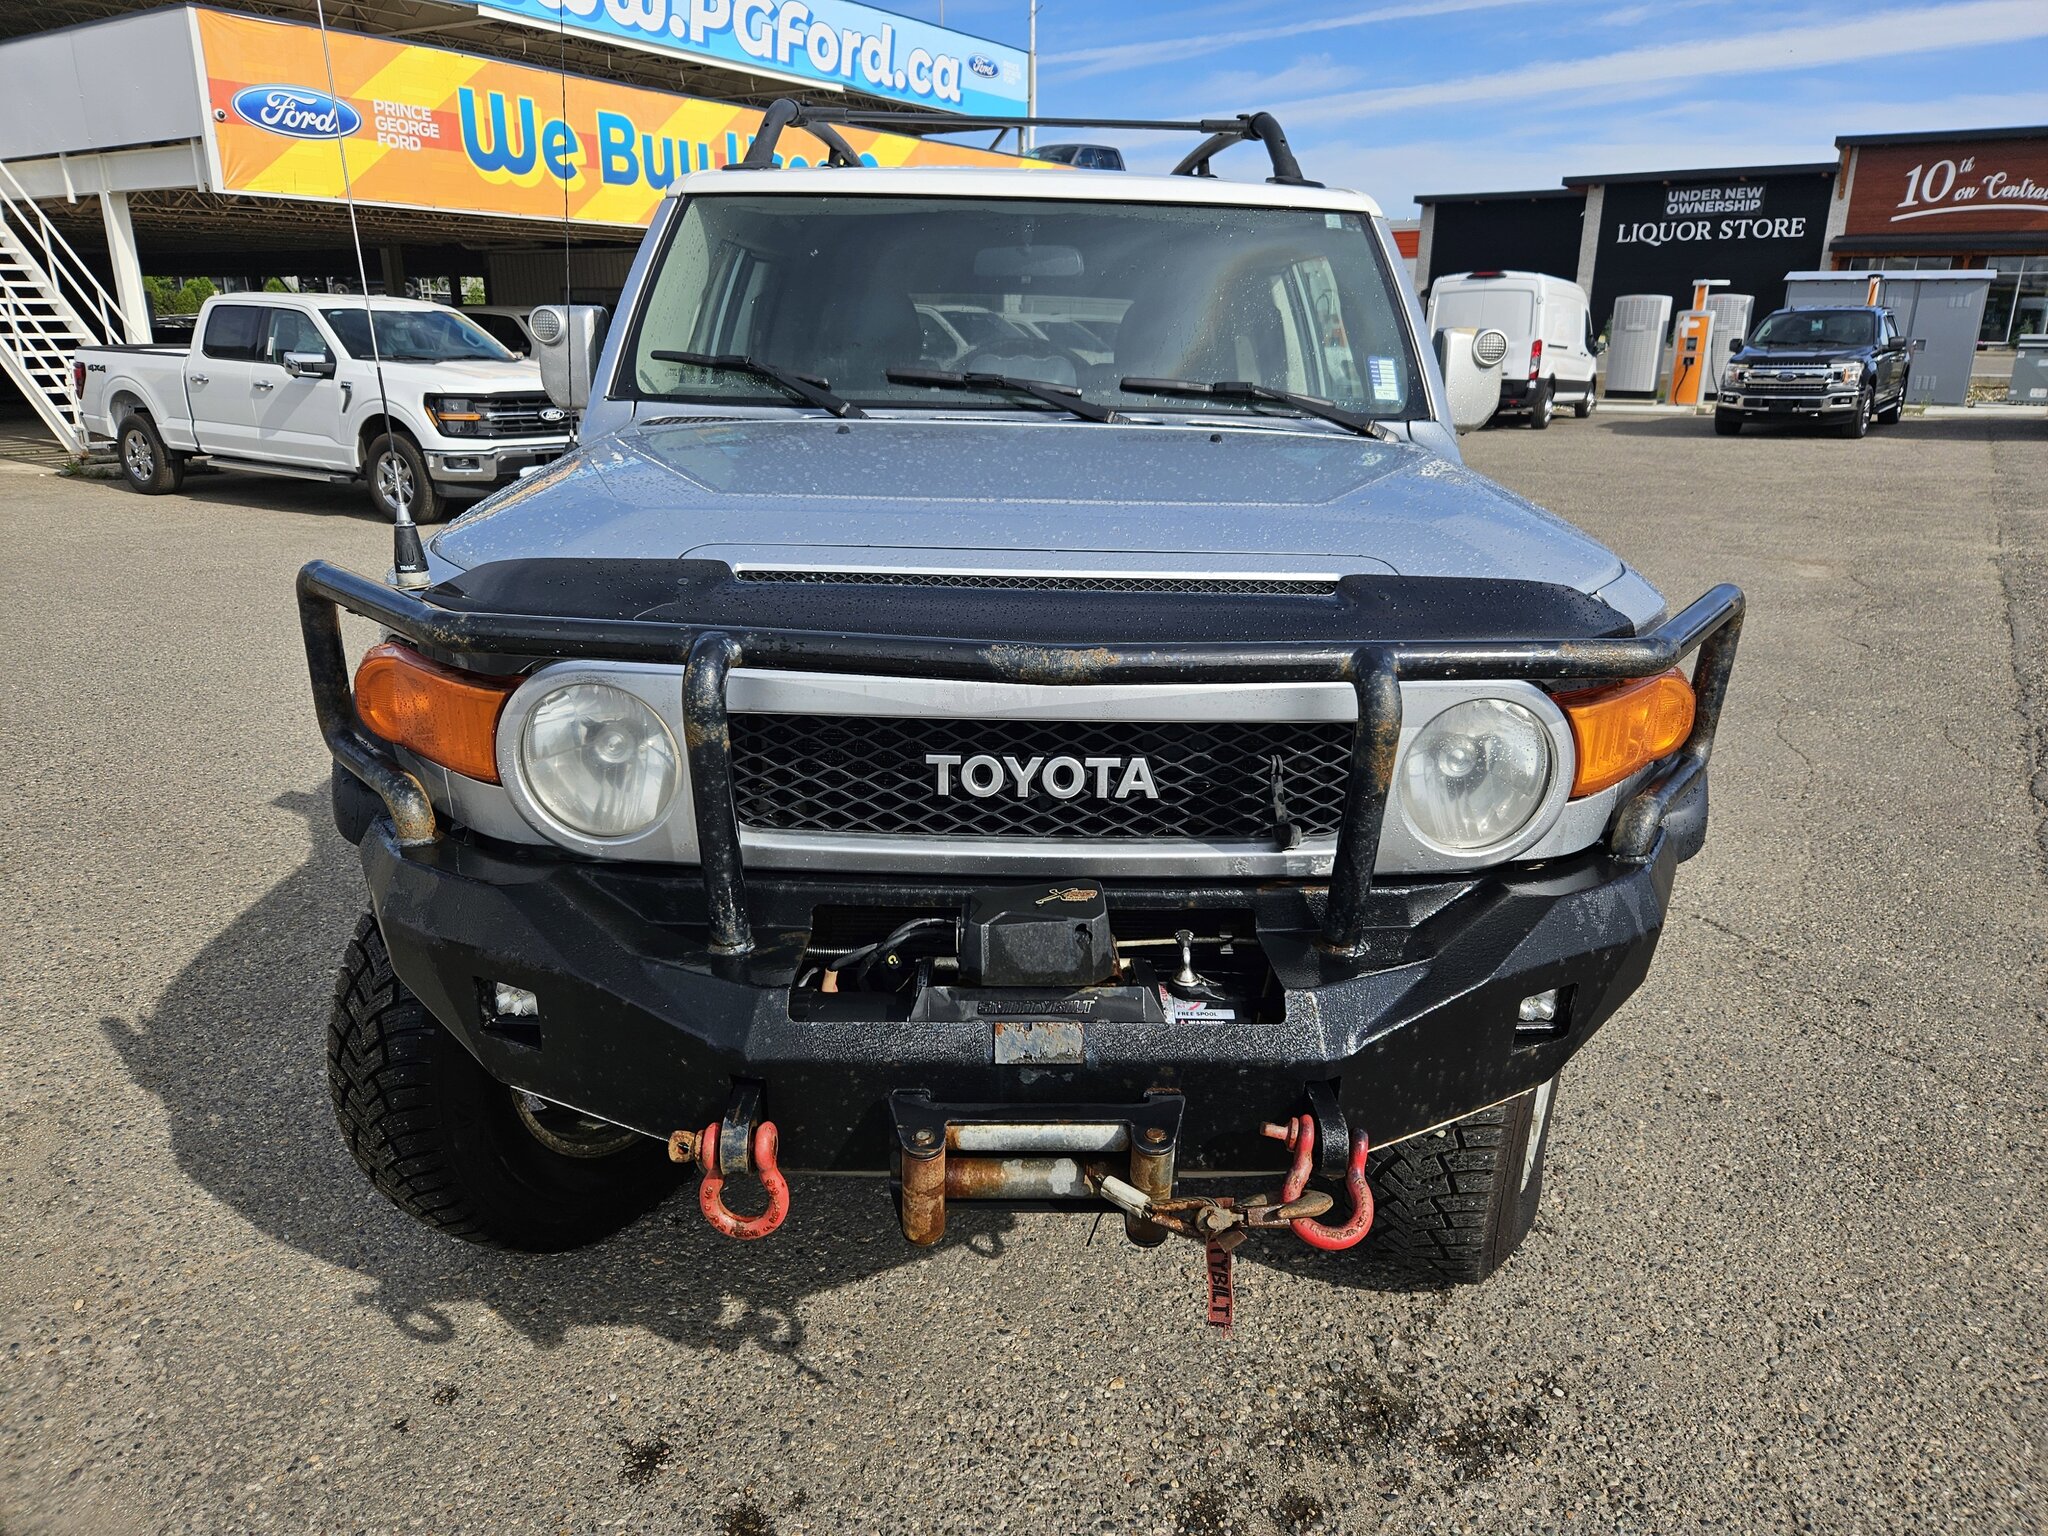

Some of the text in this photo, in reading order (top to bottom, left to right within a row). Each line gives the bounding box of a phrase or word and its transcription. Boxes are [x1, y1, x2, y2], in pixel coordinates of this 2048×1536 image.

[973, 55, 995, 76] Ford
[260, 91, 336, 133] Ford
[373, 99, 432, 122] PRINCE
[375, 115, 440, 138] GEORGE
[457, 87, 579, 180] We
[377, 132, 421, 151] FORD
[1668, 186, 1763, 203] UNDER NEW
[1953, 186, 1979, 201] on
[1666, 199, 1761, 215] OWNERSHIP
[1616, 217, 1806, 247] LIQUOR STORE
[925, 754, 1159, 799] TOYOTA
